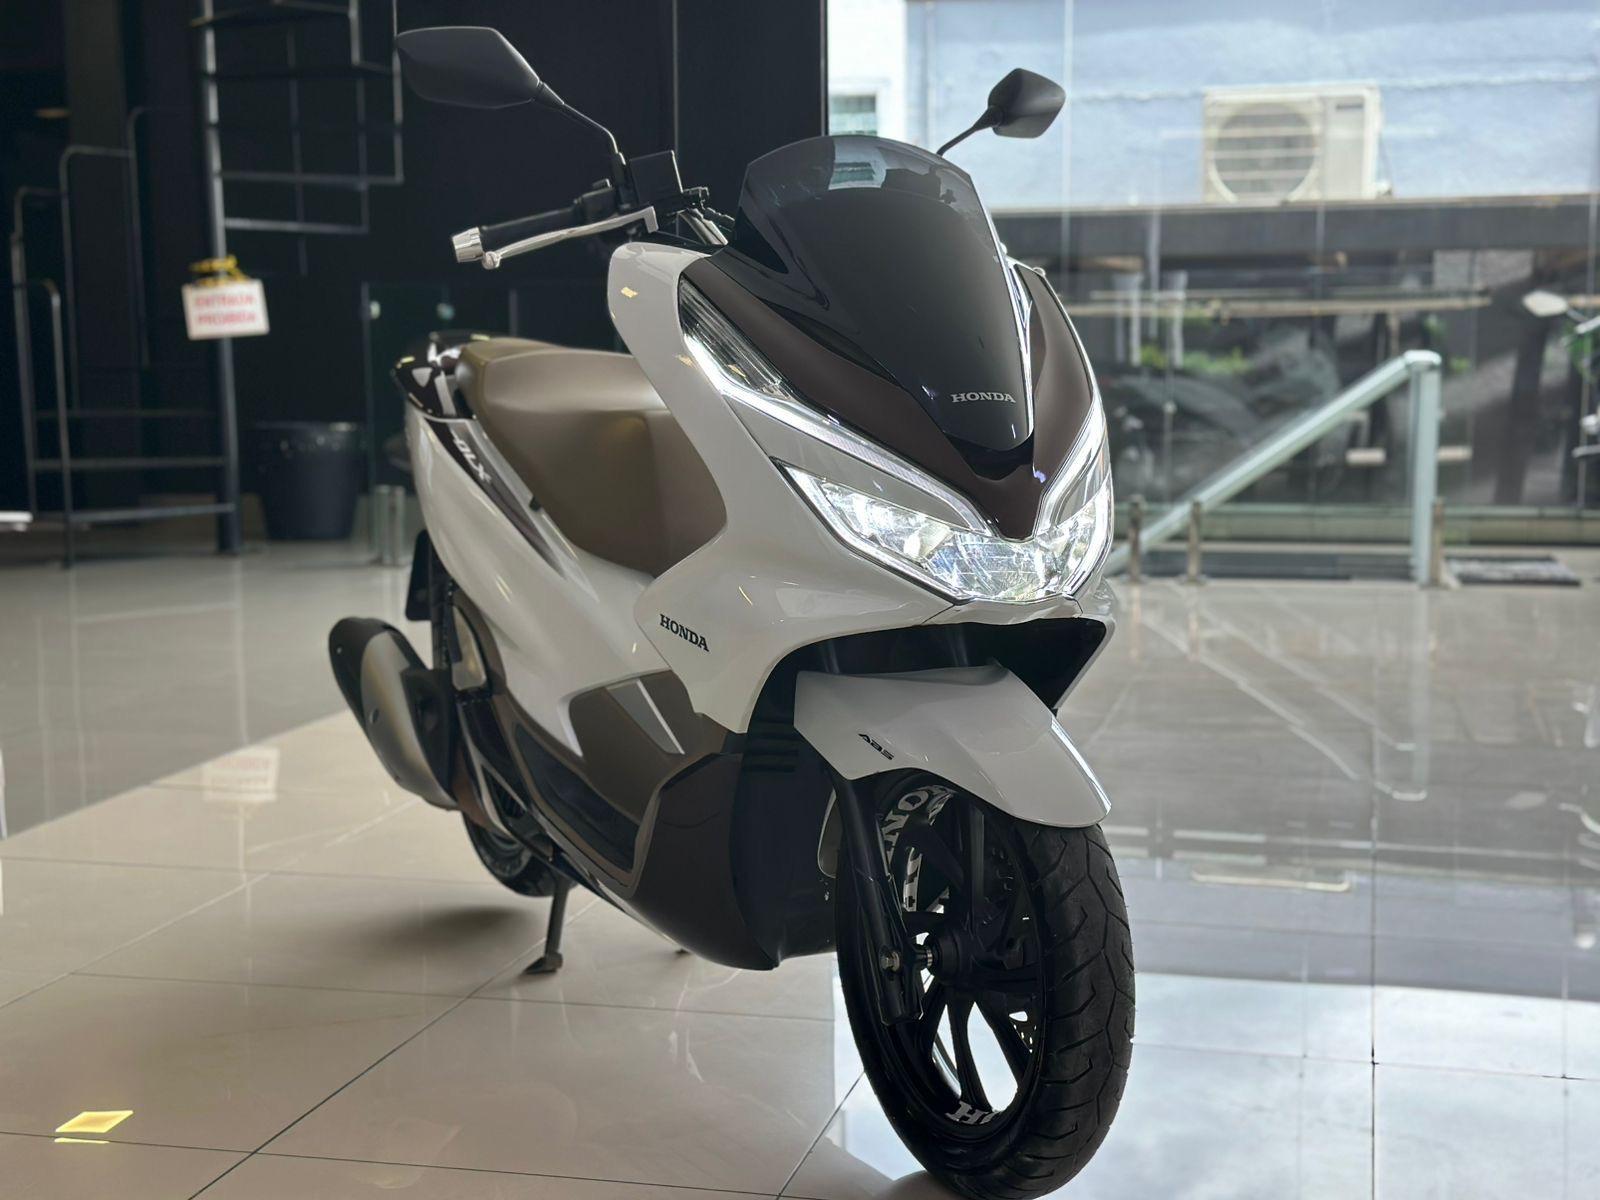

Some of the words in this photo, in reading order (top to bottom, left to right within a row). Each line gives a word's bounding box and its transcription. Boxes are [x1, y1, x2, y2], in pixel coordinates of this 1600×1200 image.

[950, 391, 1016, 404] HONDA
[659, 613, 710, 653] HONDA
[858, 733, 895, 761] ABS
